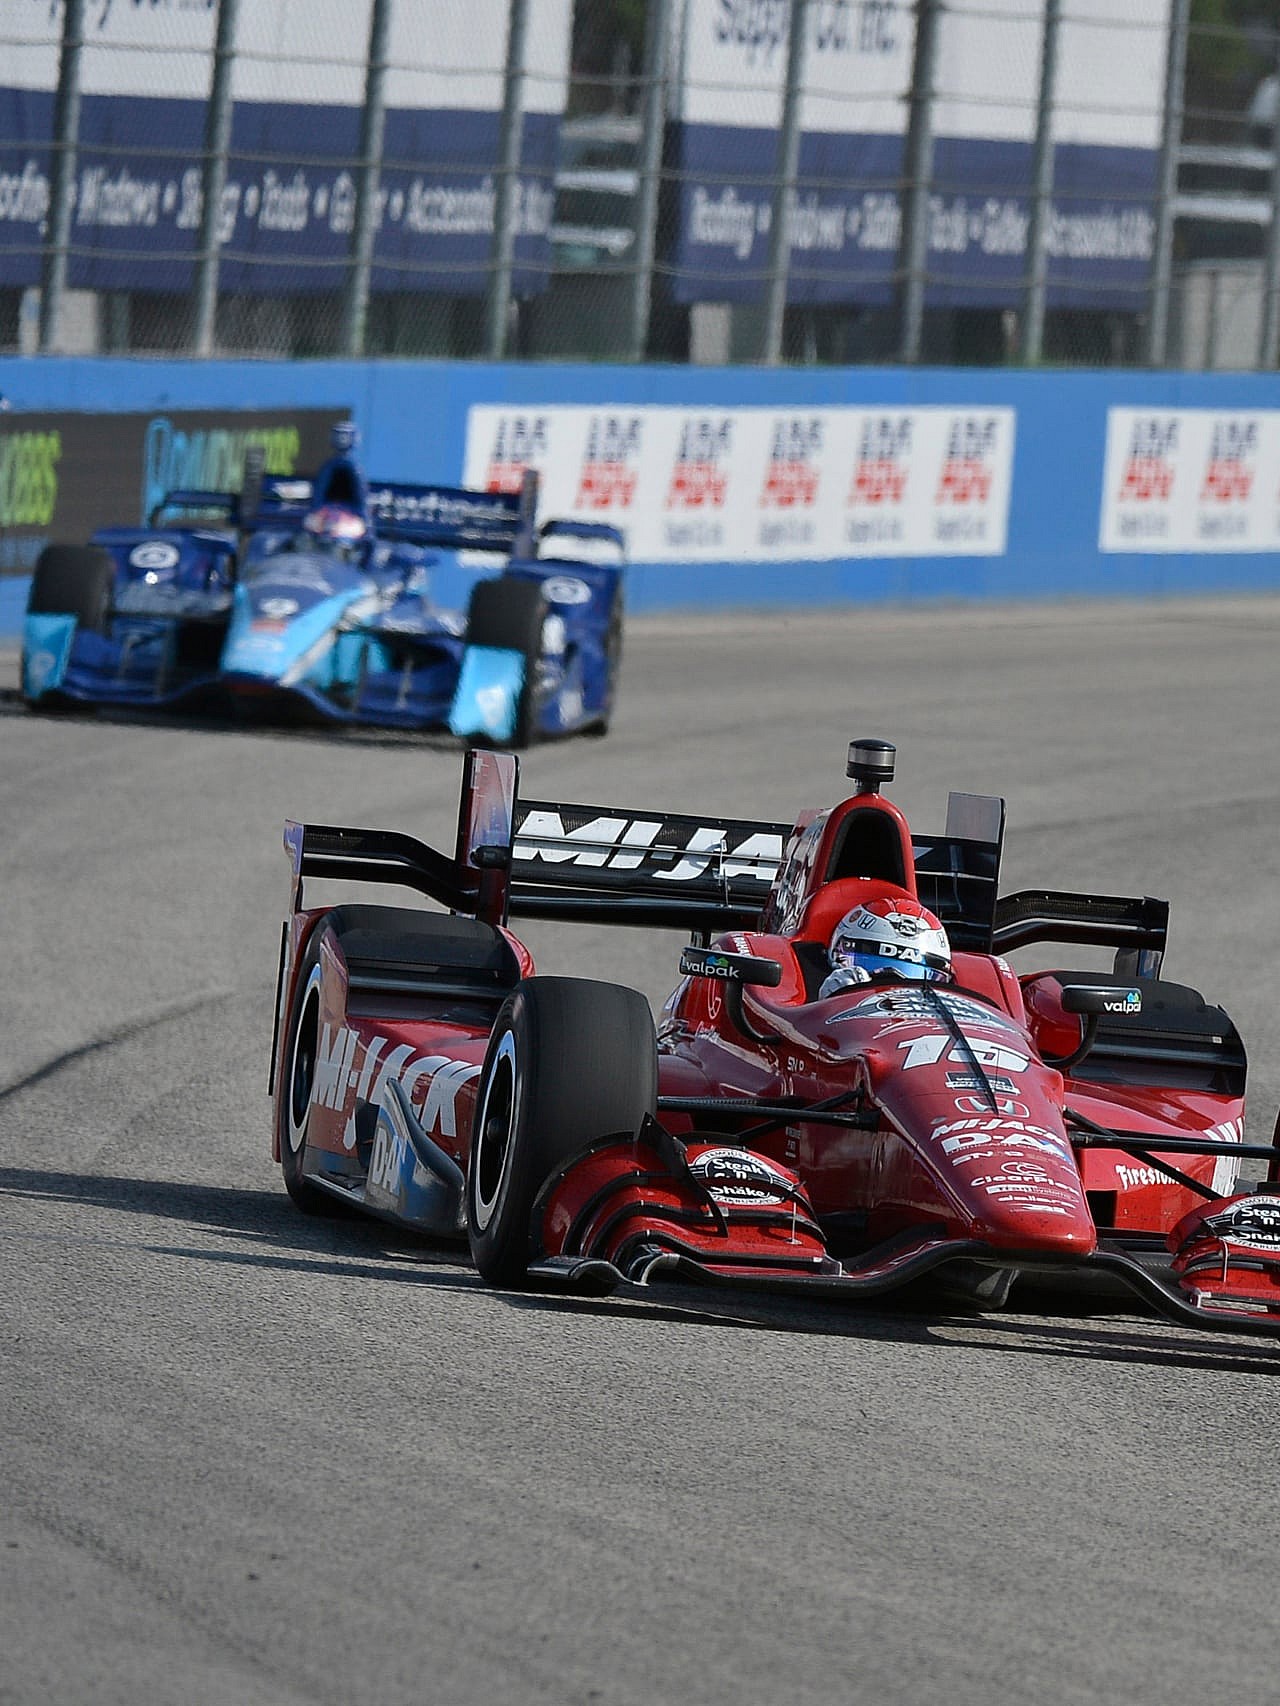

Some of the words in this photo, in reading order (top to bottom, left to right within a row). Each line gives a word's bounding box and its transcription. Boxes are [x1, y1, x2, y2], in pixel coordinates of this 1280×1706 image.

[686, 961, 740, 979] valpak
[898, 1034, 1030, 1073] 15
[930, 1118, 1066, 1148] MI-JACK
[712, 1159, 764, 1175] Steak
